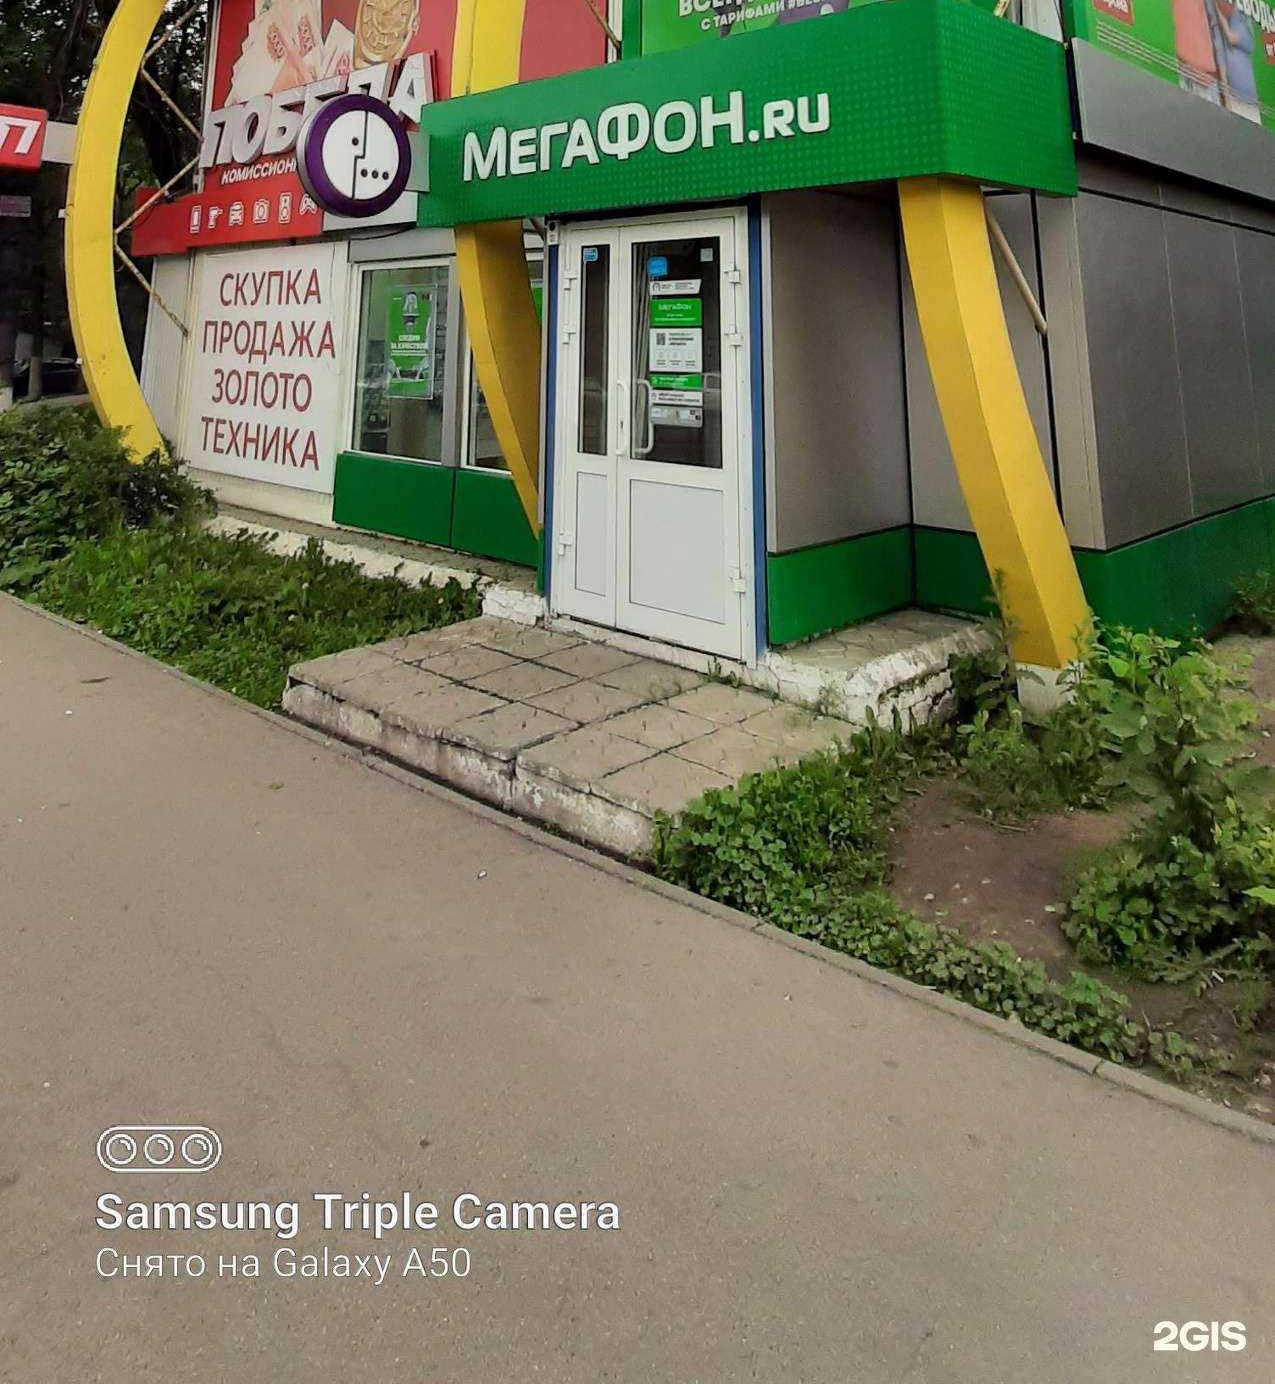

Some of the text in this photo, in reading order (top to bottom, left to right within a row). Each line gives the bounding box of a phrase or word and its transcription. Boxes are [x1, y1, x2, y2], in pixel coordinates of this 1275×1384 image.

[701, 18, 711, 31] С
[713, 0, 786, 28] ТАРИФАМИ
[219, 268, 322, 307] СКУПКА
[202, 319, 337, 365] ПРОДАЖА
[212, 367, 312, 413] ЗОЛОТО
[201, 415, 320, 472] ТЕХНИКА
